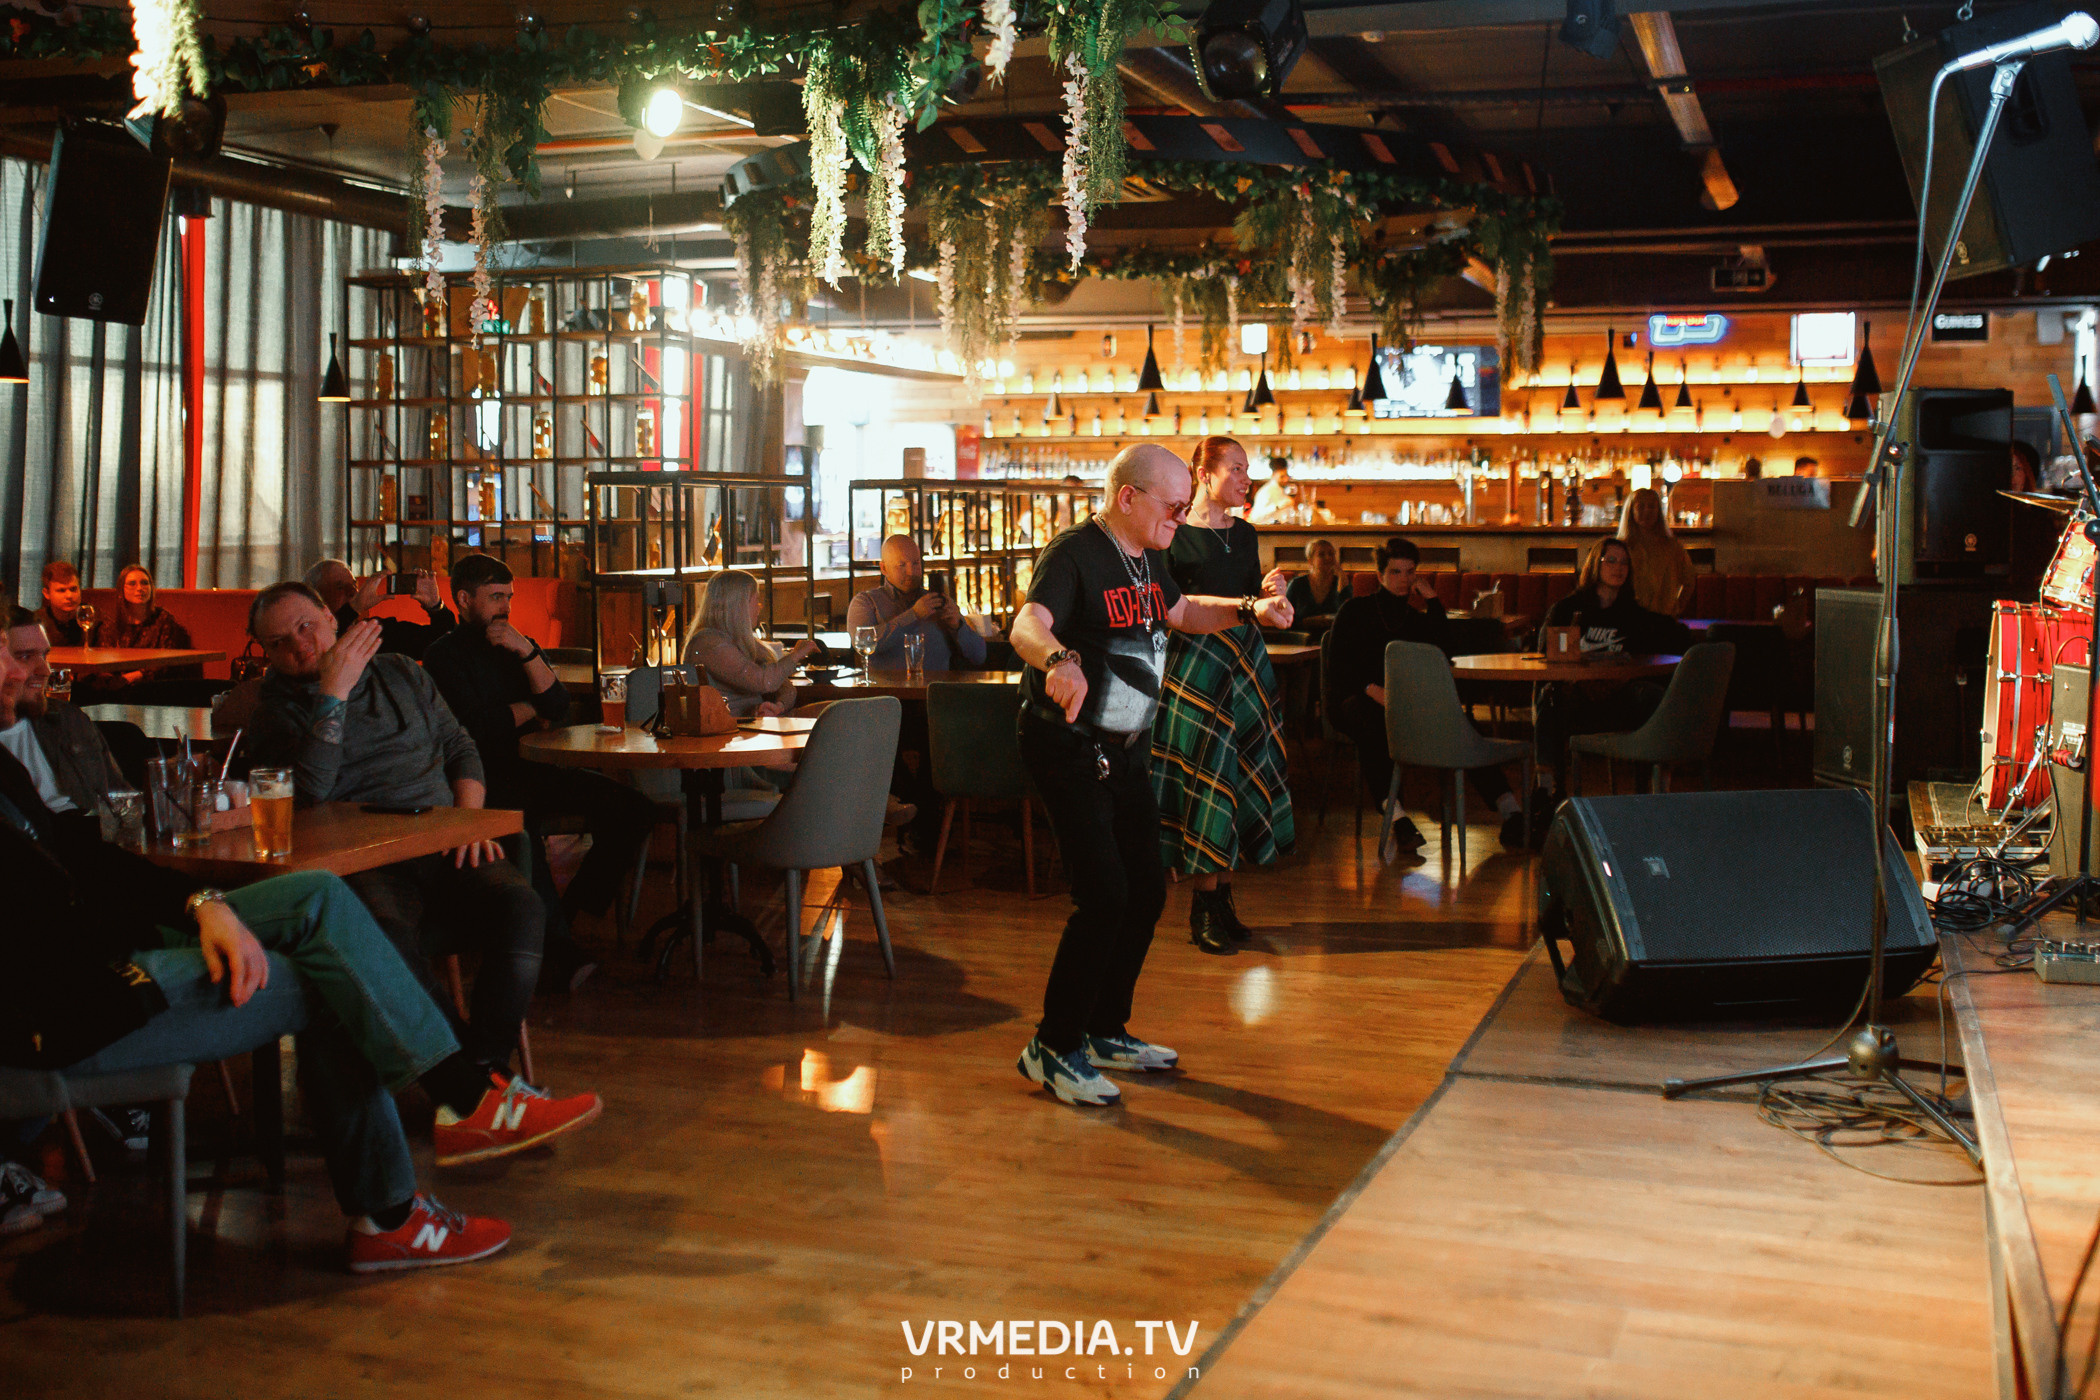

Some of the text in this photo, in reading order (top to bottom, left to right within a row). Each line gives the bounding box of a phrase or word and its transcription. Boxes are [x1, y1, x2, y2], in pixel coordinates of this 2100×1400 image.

[1586, 627, 1618, 641] NIKE
[490, 1102, 527, 1130] N
[411, 1224, 449, 1251] N
